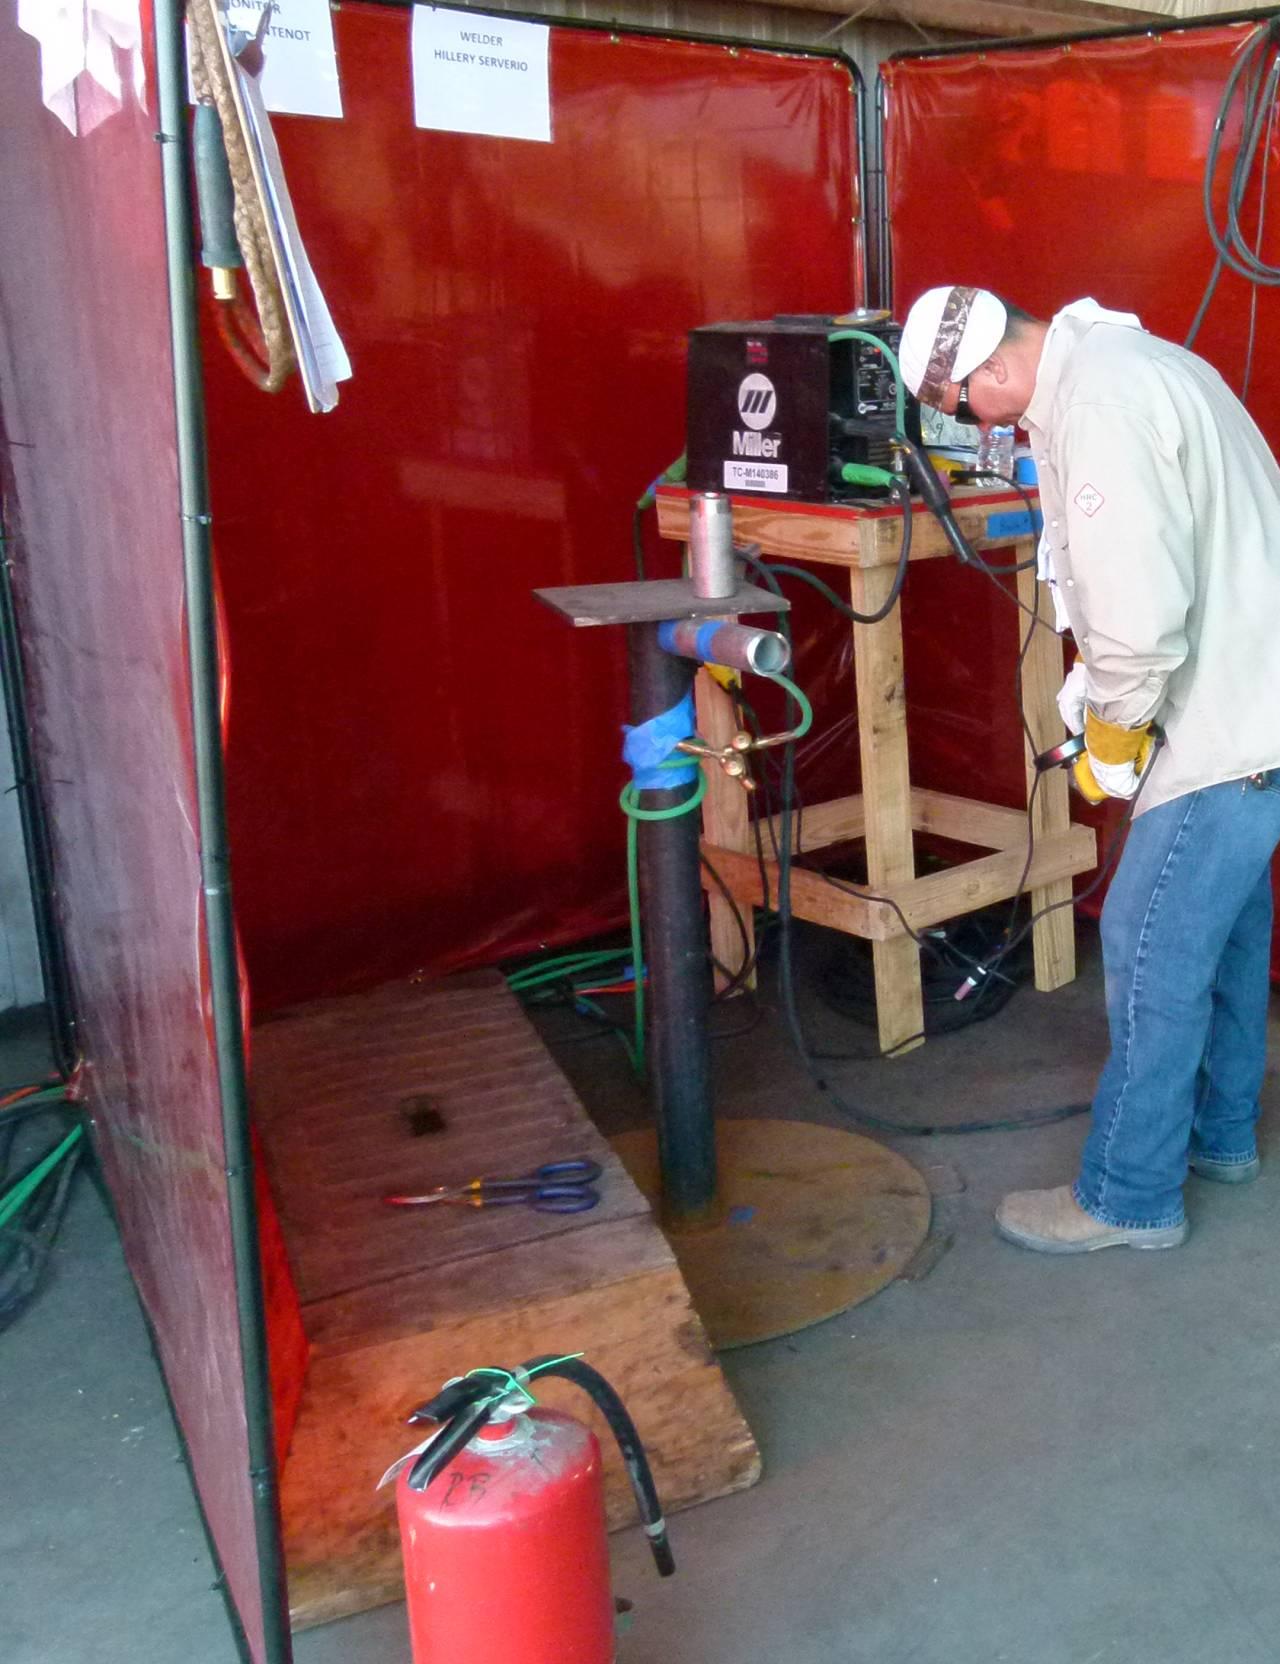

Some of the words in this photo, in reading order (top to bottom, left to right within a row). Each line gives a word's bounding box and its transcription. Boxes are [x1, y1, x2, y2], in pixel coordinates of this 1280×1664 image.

[231, 0, 281, 14] ONITOR
[460, 31, 503, 46] WELDER
[434, 48, 476, 64] HILLERY
[478, 55, 528, 72] SERVERIO
[733, 431, 781, 458] Miller
